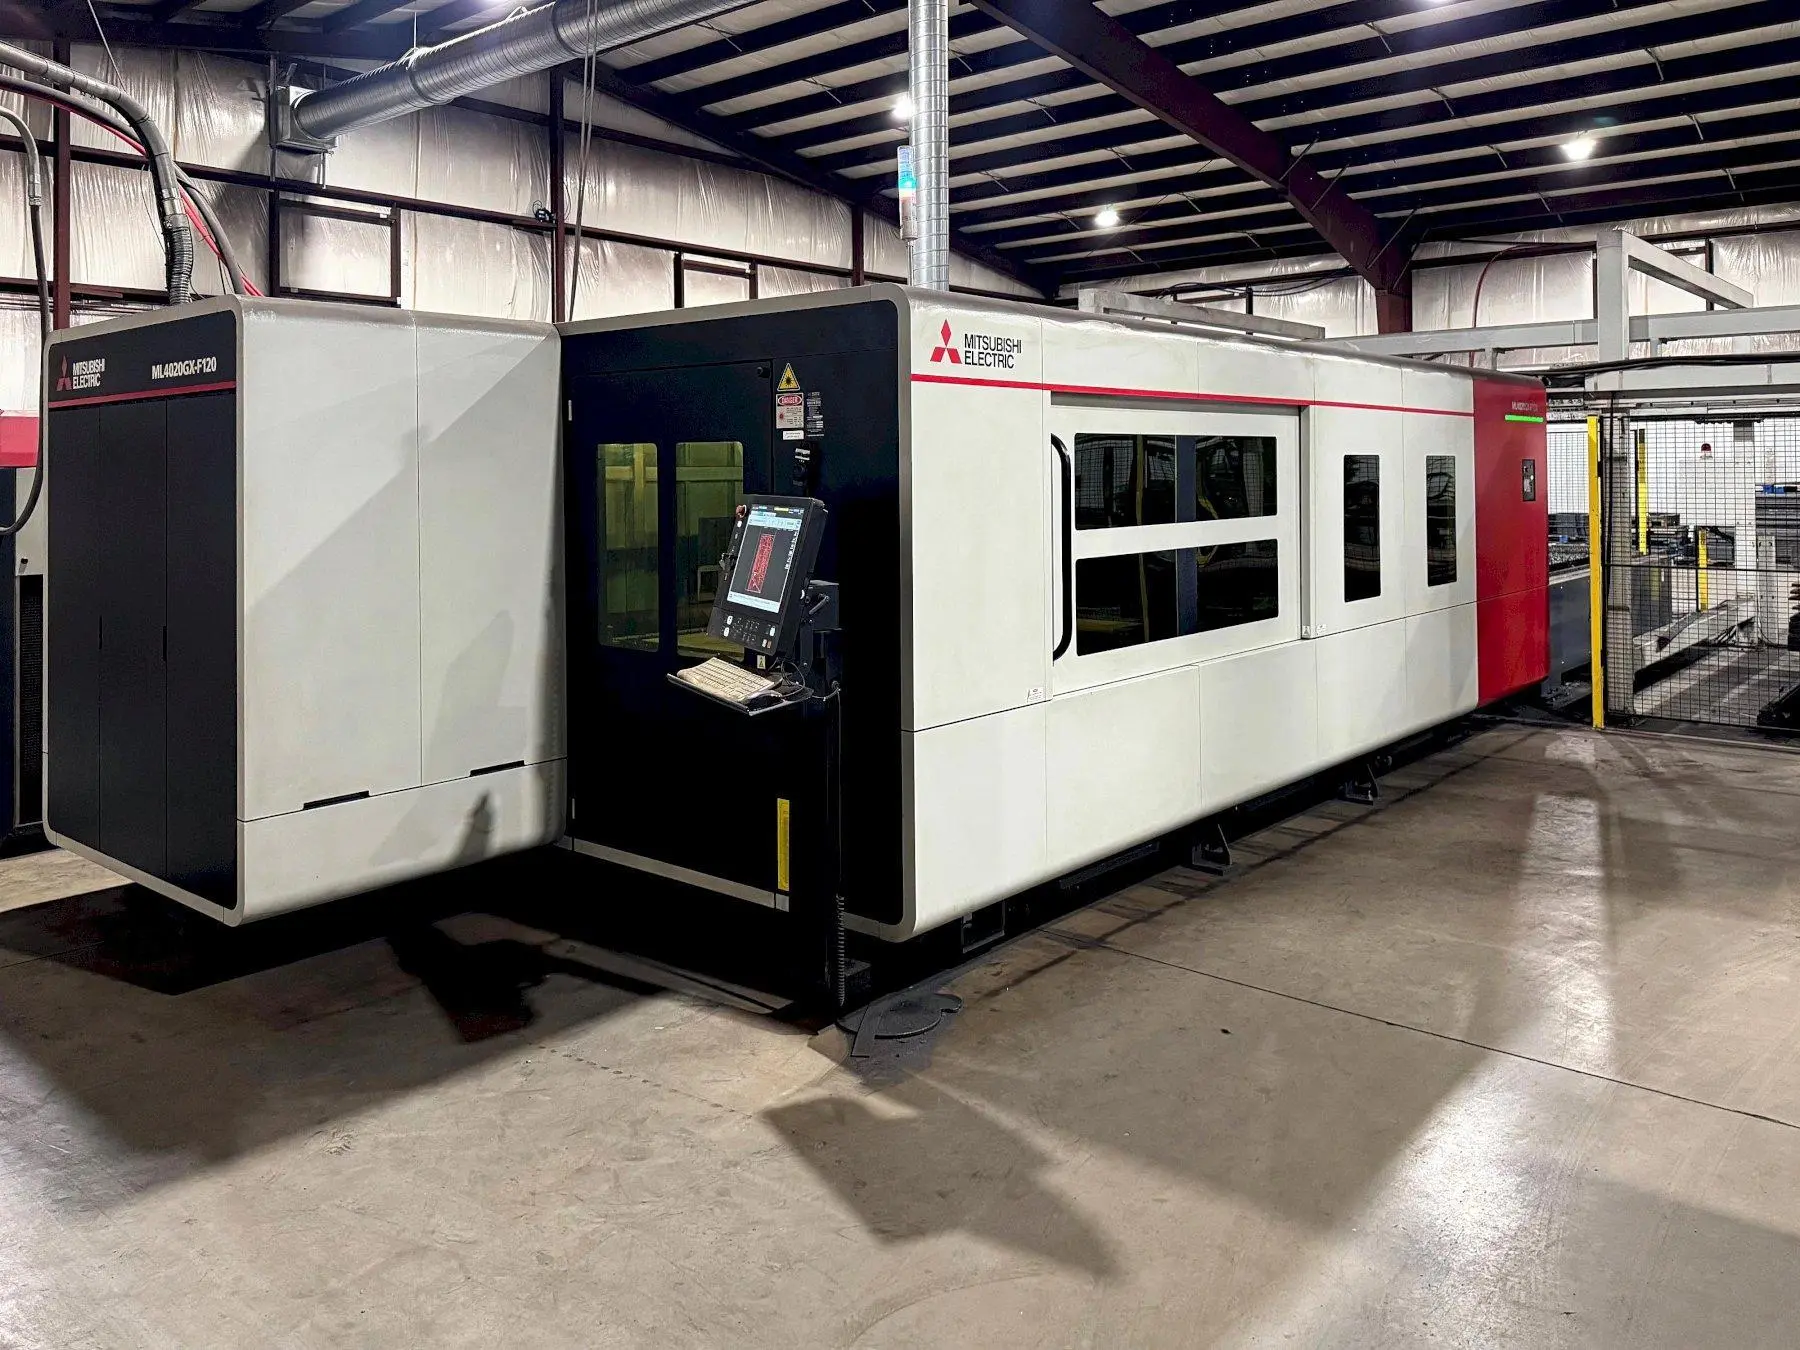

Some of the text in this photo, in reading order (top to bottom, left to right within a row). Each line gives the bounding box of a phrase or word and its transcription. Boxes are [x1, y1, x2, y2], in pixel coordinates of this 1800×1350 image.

[964, 334, 1021, 353] MITSUBISHI
[73, 359, 105, 375] MITSUBISHI
[151, 357, 217, 379] ML4020GX-F120
[964, 351, 1014, 368] ELECTRIC
[73, 373, 101, 389] ELECTRIC
